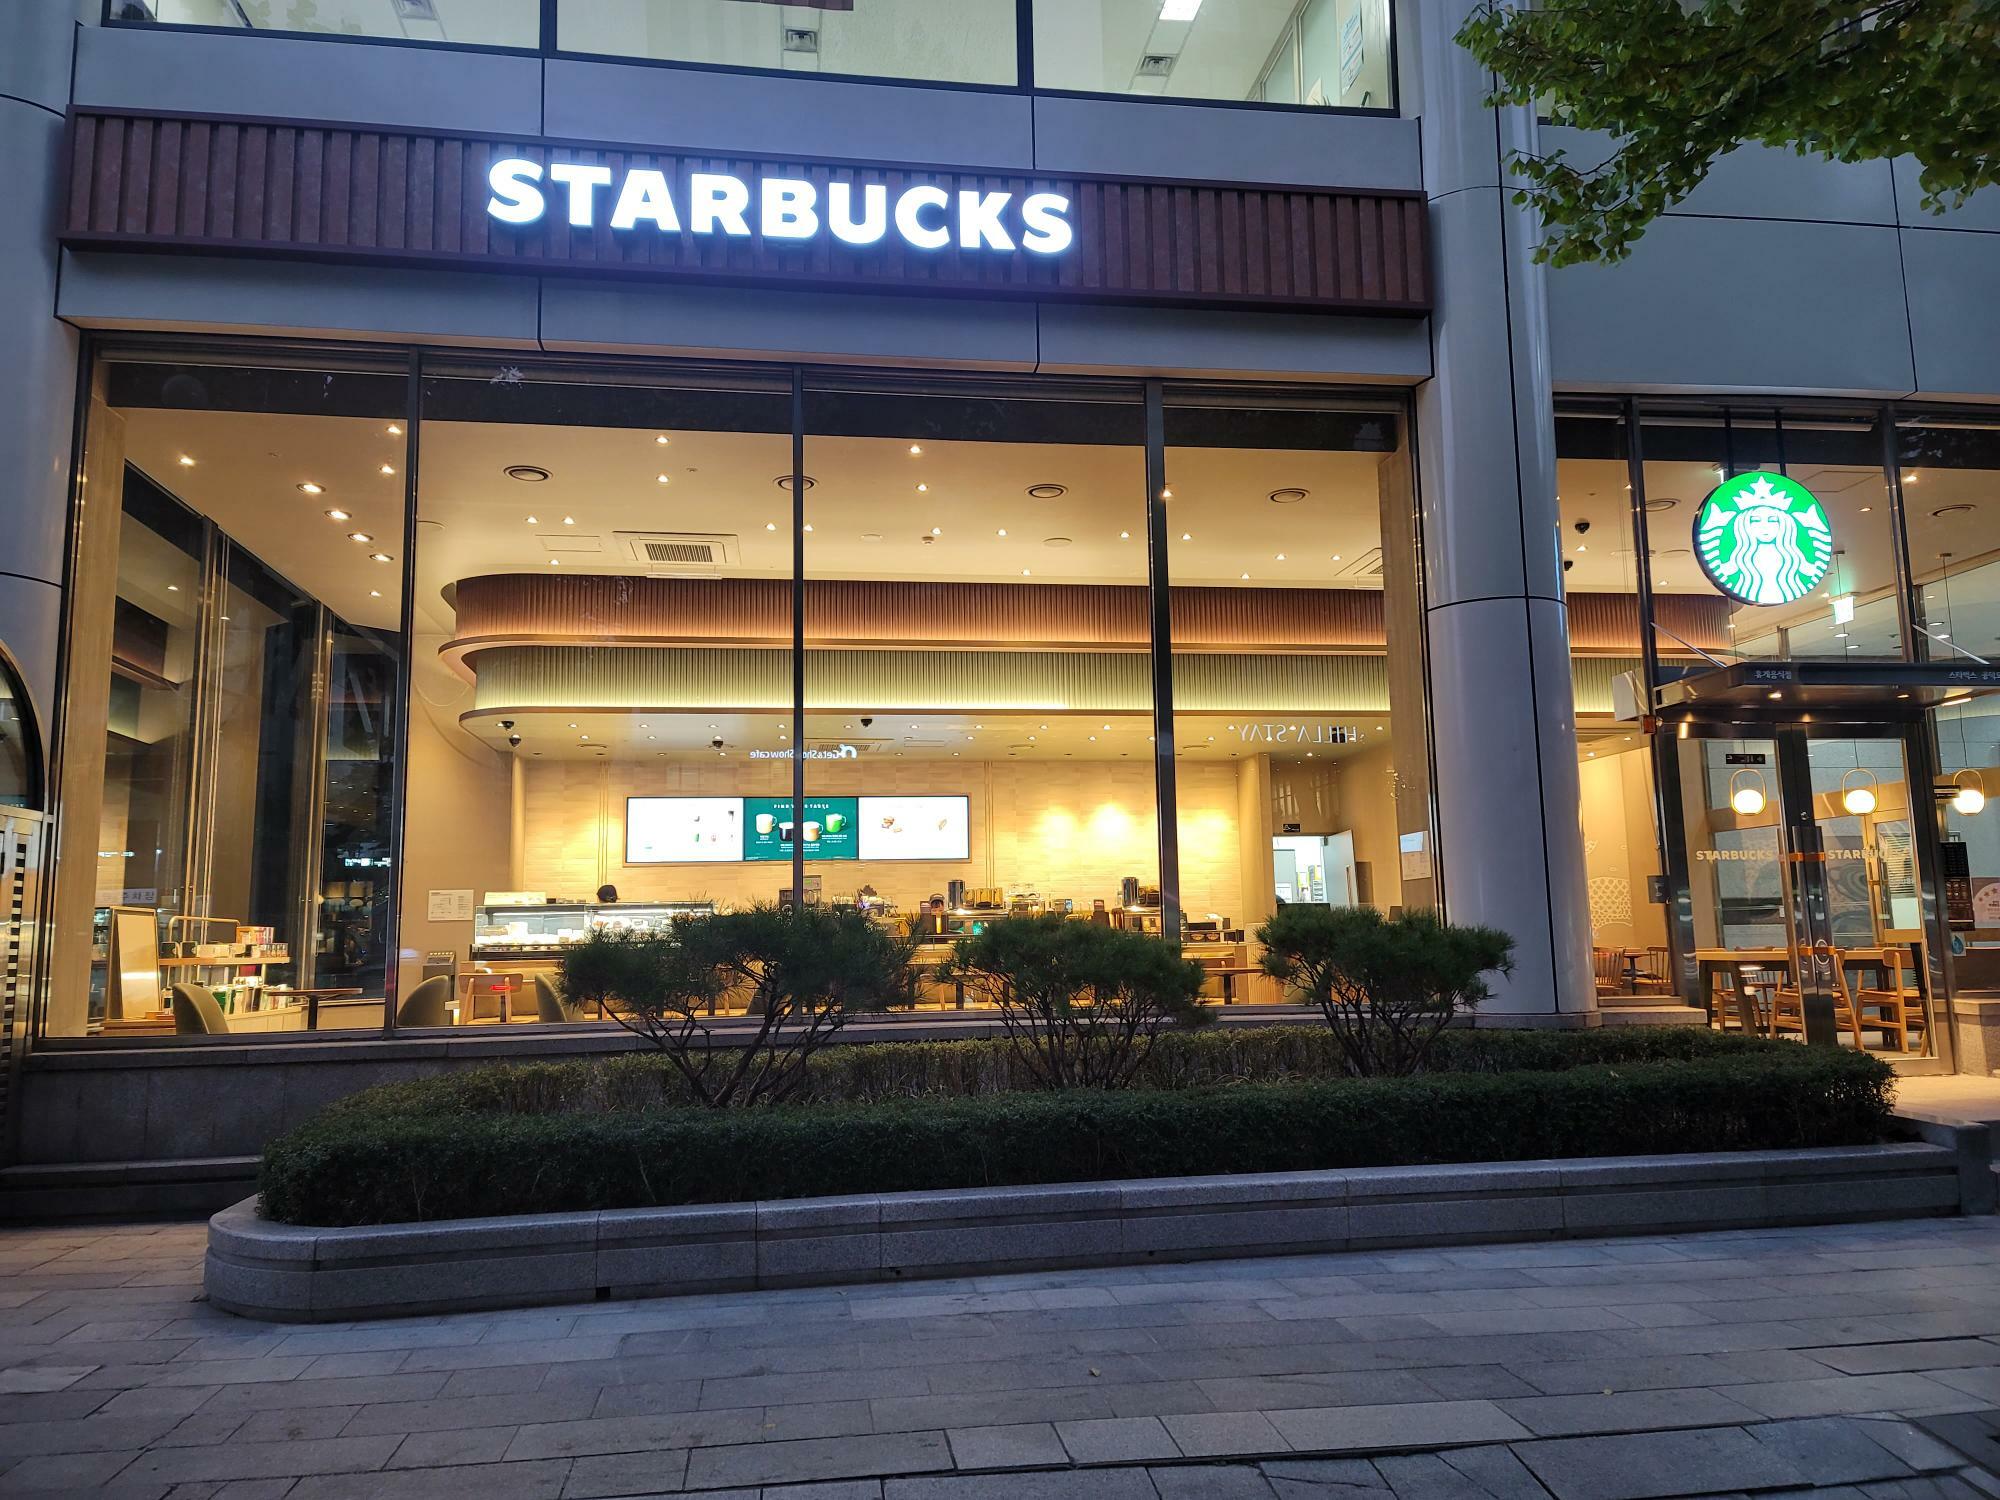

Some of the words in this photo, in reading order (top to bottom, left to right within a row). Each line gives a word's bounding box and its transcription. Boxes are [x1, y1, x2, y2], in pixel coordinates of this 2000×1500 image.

[486, 158, 1074, 255] STARBUCKS
[1696, 850, 1774, 861] STARBUCKS
[1828, 849, 1911, 860] STARBUC
